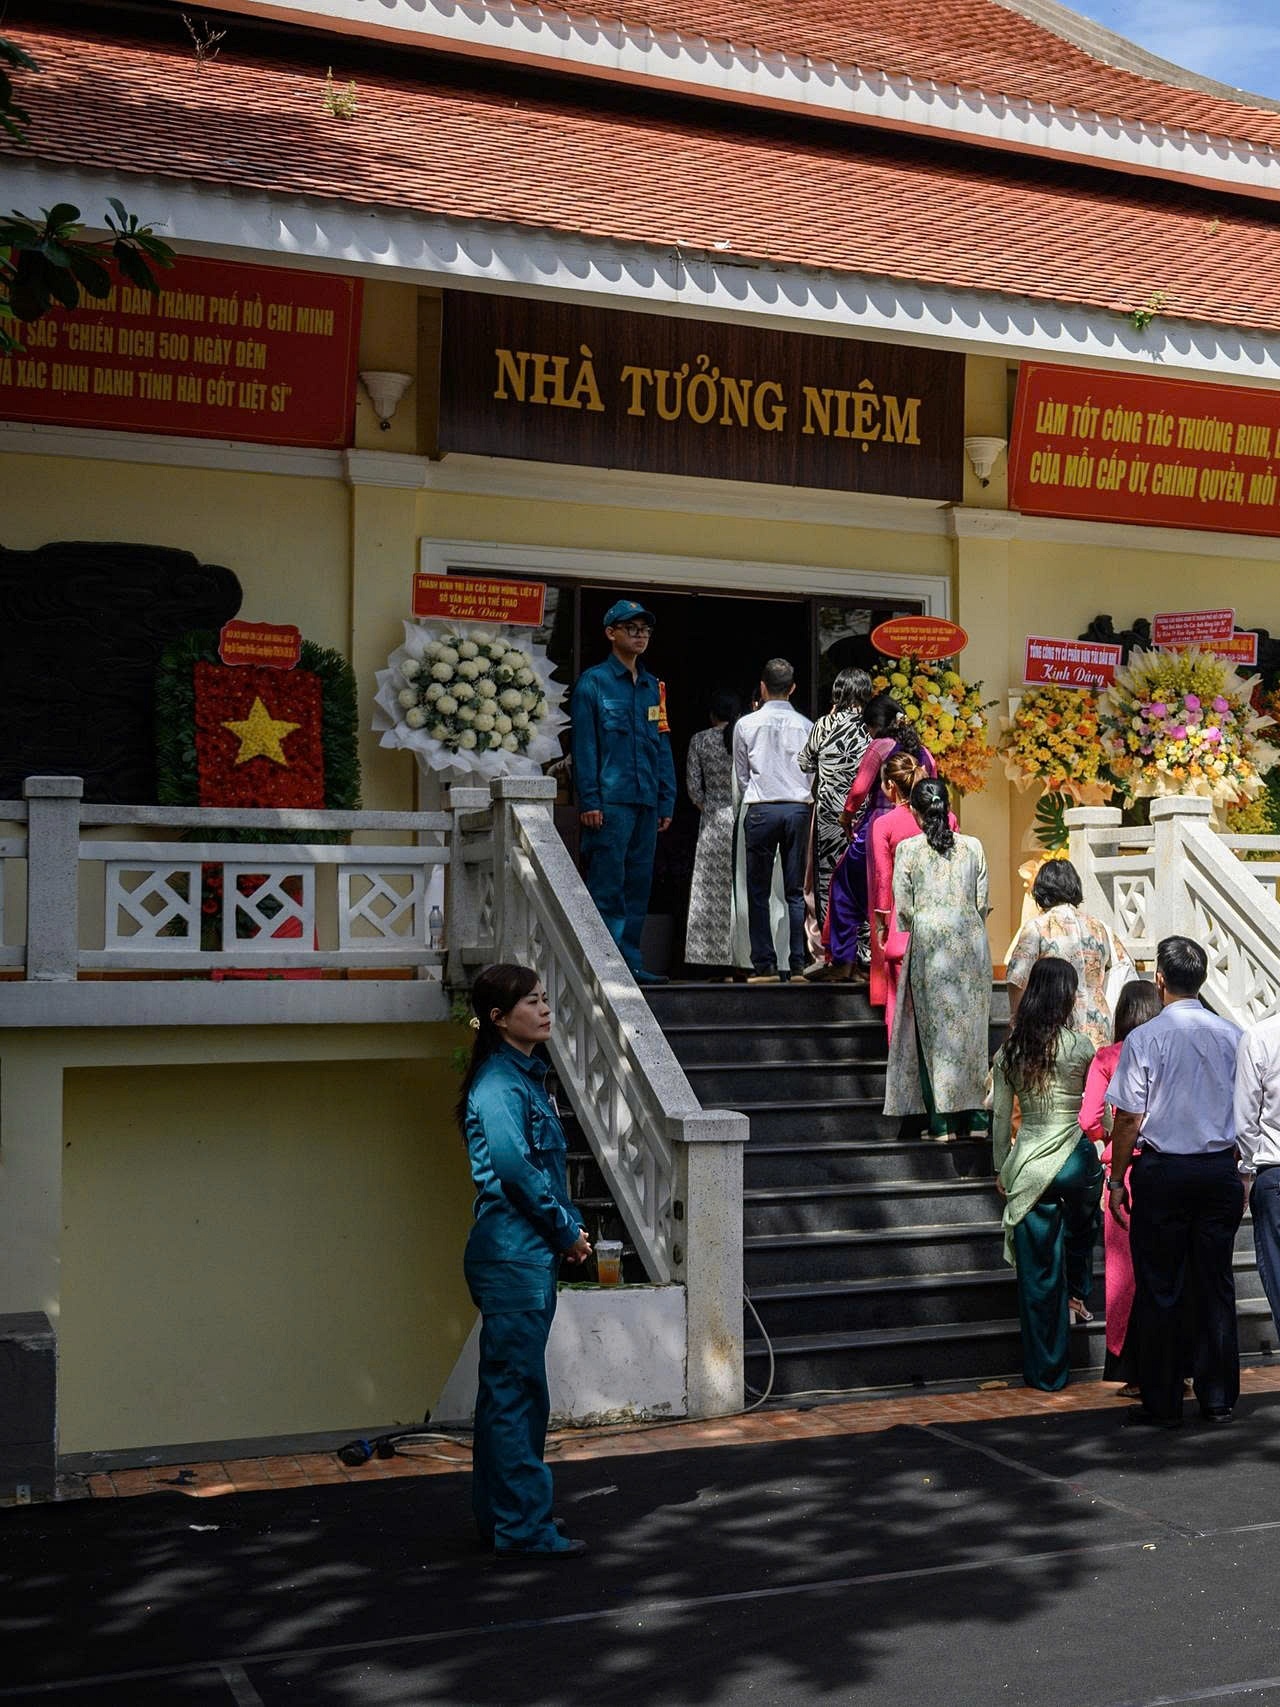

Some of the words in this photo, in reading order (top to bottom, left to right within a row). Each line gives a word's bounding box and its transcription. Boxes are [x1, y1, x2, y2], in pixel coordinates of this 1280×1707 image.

[157, 288, 205, 322] THÀNH
[209, 290, 239, 326] PHỐ
[243, 292, 263, 328] HỒ
[267, 301, 293, 332] CHÍ
[296, 306, 334, 336] MINH
[158, 332, 190, 361] 500
[193, 333, 233, 365] NGÀY
[235, 337, 268, 370] ĐÊM
[17, 356, 48, 389] XÁC
[51, 362, 89, 396] ĐỊNH
[94, 367, 134, 397] DANH
[138, 368, 173, 401] TÍNH
[177, 372, 202, 404] HÀI
[206, 371, 236, 407] CỐT
[239, 379, 268, 415] LIỆT
[494, 343, 605, 412] NHÀ
[620, 354, 787, 432] TƯỞNG
[802, 378, 921, 453] NIỆM
[1035, 396, 1069, 436] LÀM
[1071, 395, 1101, 439] TỐT
[1101, 404, 1143, 444] CÔNG
[1146, 409, 1174, 447] TÁC
[1177, 415, 1234, 454] THƯƠNG
[1234, 423, 1271, 461] BINH,
[1029, 444, 1060, 485] CỦA
[1063, 446, 1095, 488] MỖI
[1096, 448, 1127, 491] CẤP
[1128, 453, 1151, 497] ỦY,
[1151, 460, 1198, 498] CHÍNH
[1199, 460, 1245, 506] QUYỀN,
[1247, 465, 1278, 506] MỖI
[1040, 663, 1070, 681] Kính
